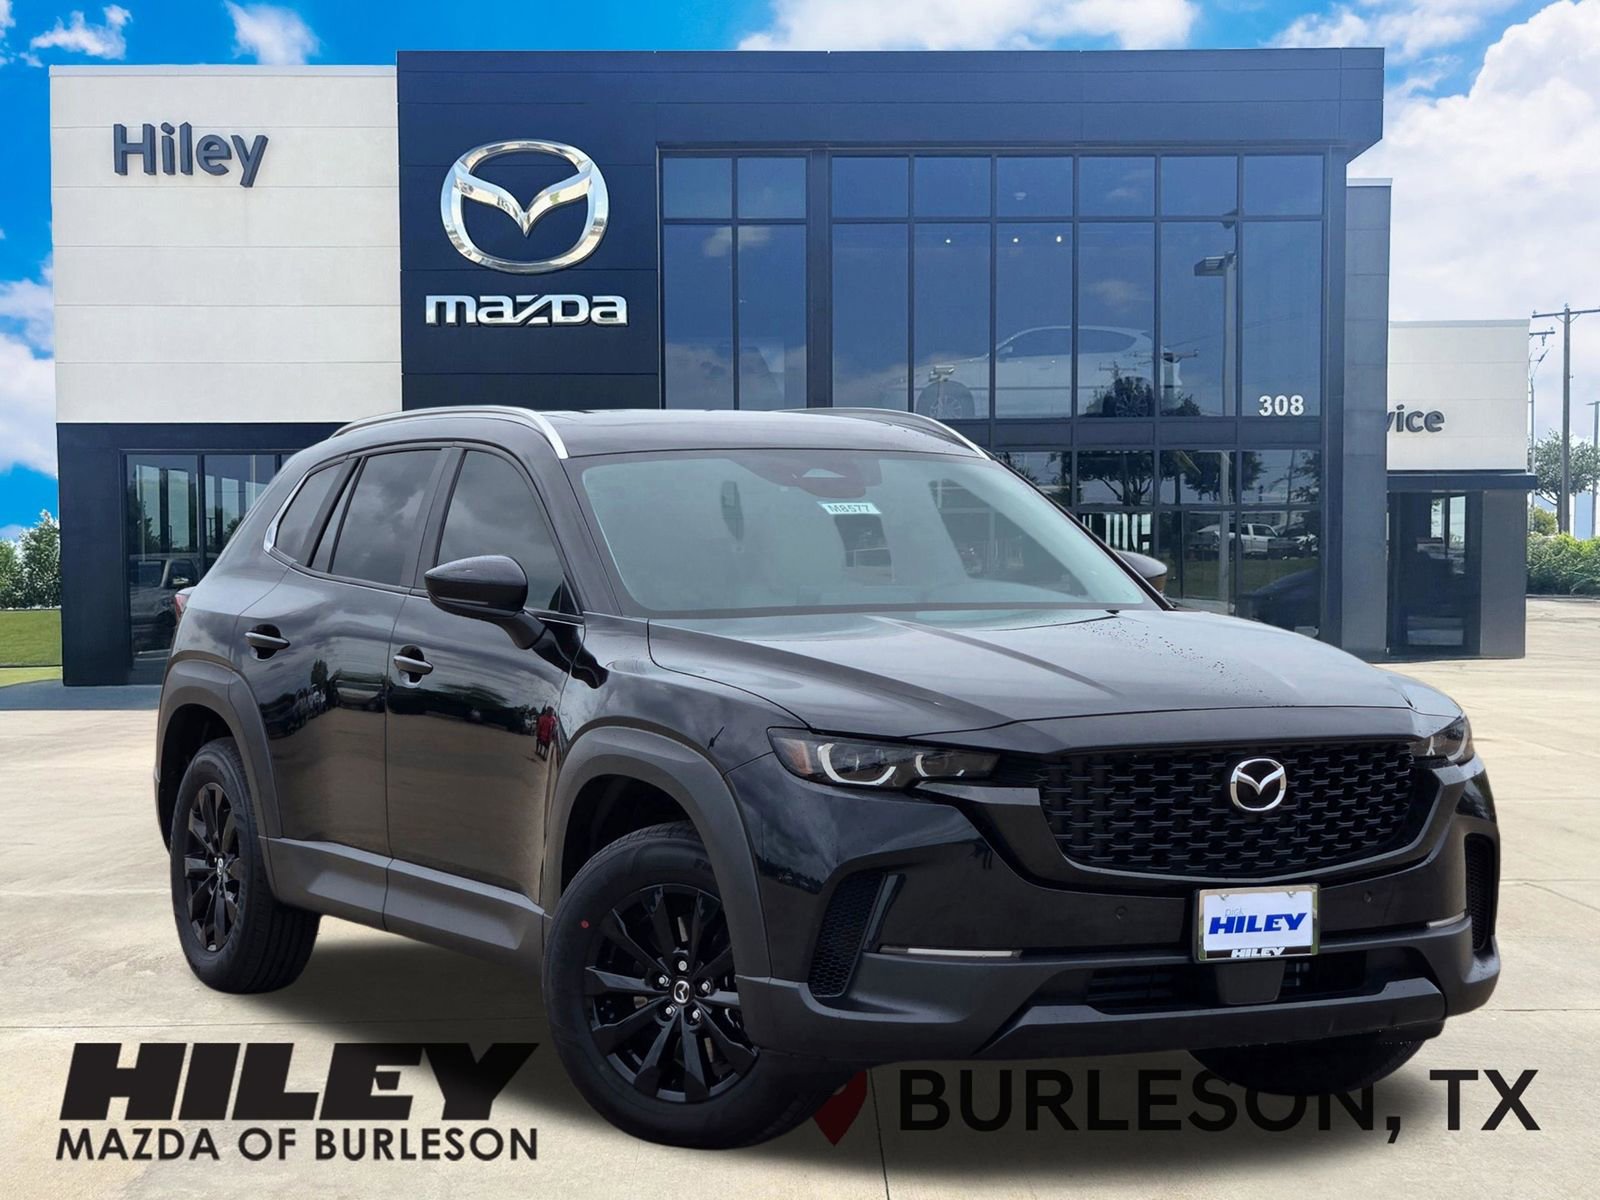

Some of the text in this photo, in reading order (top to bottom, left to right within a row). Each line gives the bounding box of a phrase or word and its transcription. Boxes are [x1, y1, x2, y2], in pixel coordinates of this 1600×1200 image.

[113, 122, 269, 188] Hiley
[425, 294, 629, 327] mazda
[1259, 395, 1304, 416] 308
[828, 504, 870, 513] M8577
[1208, 912, 1307, 935] HILEY
[1231, 947, 1285, 958] HILEY
